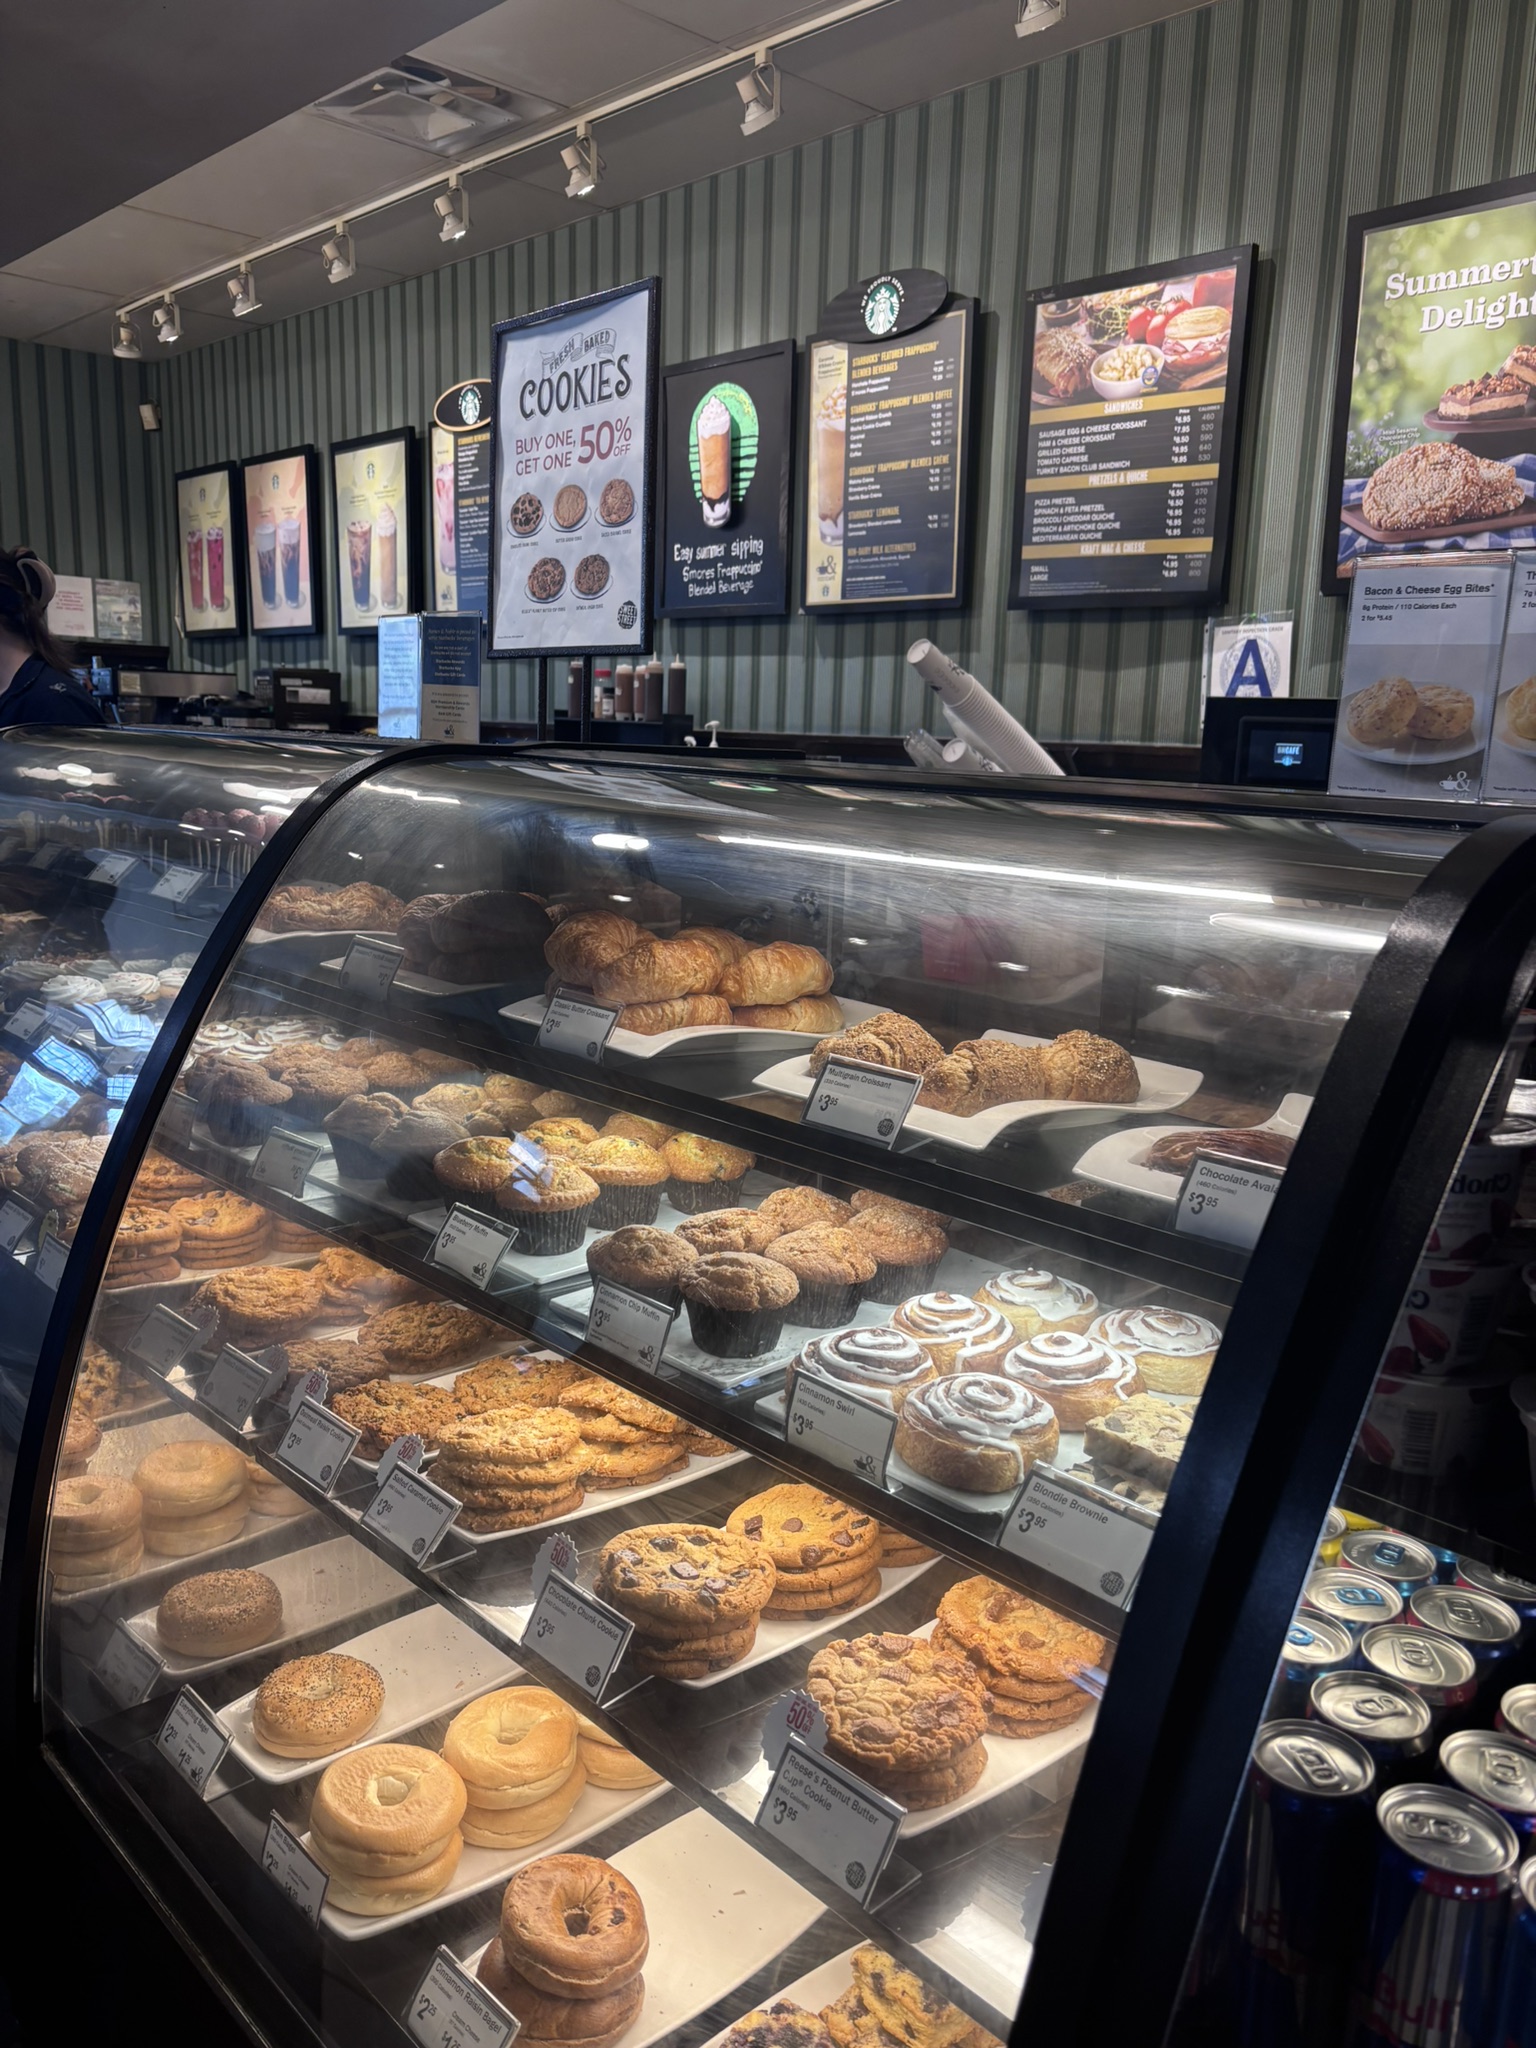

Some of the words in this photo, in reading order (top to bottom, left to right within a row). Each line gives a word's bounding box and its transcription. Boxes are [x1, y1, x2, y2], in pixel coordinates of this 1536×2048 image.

[867, 276, 891, 294] PROUDLY
[892, 277, 905, 296] SERVE
[549, 338, 575, 374] FRESH
[584, 331, 610, 352] BAKED
[519, 354, 632, 420] COOKIES
[1104, 399, 1143, 414] SANDWICHES
[1038, 440, 1052, 448] HAM
[1057, 436, 1080, 446] CHEESE
[1081, 433, 1116, 443] CROISSANT
[1201, 423, 1214, 431] 520
[1039, 428, 1066, 439] SAUSAGE
[1067, 427, 1080, 436] EGG
[1086, 424, 1111, 434] CHEESE
[1111, 419, 1148, 431] CROISSANT
[515, 436, 542, 455] BUY
[544, 429, 576, 450] ONE,
[577, 416, 632, 464] 50%
[515, 457, 540, 476] GET
[543, 451, 572, 470] ONE
[613, 444, 631, 457] OFF
[1037, 448, 1061, 457] GRILLED
[1061, 445, 1086, 455] CHEESE
[1037, 457, 1061, 467] TOMATO
[1061, 454, 1089, 464] CAPRESE
[1036, 467, 1059, 475] TURKEY
[1059, 464, 1081, 473] BACON
[1081, 463, 1098, 472] CLUB
[1098, 459, 1131, 470] SANDWICH
[1034, 507, 1059, 515] SPINACH
[1080, 504, 1104, 512] PRETZEL
[1051, 497, 1076, 505] PRETZEL
[1033, 516, 1061, 525] BROCCOLI
[1063, 514, 1090, 523] CHEDDAR
[1091, 512, 1115, 521] QUICHE
[1033, 526, 1057, 534] SPINACH
[1063, 523, 1095, 531] ARTICHOKE
[1097, 522, 1120, 530] QUICHE
[1032, 534, 1078, 543] MEDITERRANEAN
[1079, 532, 1102, 540] QUICHE
[674, 544, 693, 564] Easy
[696, 543, 726, 560] summer
[731, 535, 764, 560] sipping
[688, 580, 716, 597] Blended
[718, 580, 754, 594] Beverage
[1364, 586, 1393, 596] Bacon
[1395, 586, 1402, 595] &
[1404, 585, 1441, 595] Cheese
[1443, 584, 1462, 595] Egg
[618, 605, 637, 616] SWEET
[1372, 603, 1394, 611] Protein
[617, 614, 637, 625] STREET
[1225, 639, 1273, 698] A
[554, 1000, 571, 1011] Classic
[571, 1004, 586, 1014] Butter
[586, 1009, 610, 1020] Croissant
[828, 1068, 860, 1083] Multigrain
[861, 1076, 892, 1089] Croissant
[1200, 1167, 1249, 1187] Chocolate
[1212, 1182, 1237, 1195] Calories)
[600, 1286, 627, 1306] Cinnamon
[628, 1300, 640, 1312] Chip
[642, 1306, 660, 1321] Muffin
[798, 1382, 835, 1406] Cinnamon
[836, 1400, 855, 1416] Swirl
[330, 1428, 345, 1443] Cookie
[392, 1473, 407, 1488] Salted
[407, 1484, 427, 1503] Caramel
[426, 1499, 444, 1515] Cookie
[1032, 1482, 1068, 1505] Blondie
[1069, 1499, 1109, 1524] Brownie
[1041, 1502, 1064, 1518] Calories)
[548, 1586, 578, 1611] Chocolate
[577, 1606, 597, 1625] Chunk
[597, 1621, 620, 1641] Cookie
[788, 1755, 820, 1784] Reese's
[820, 1778, 851, 1806] Peanut
[851, 1799, 880, 1825] Butter
[804, 1785, 832, 1811] Cookie
[435, 1962, 465, 1996] Cinnamon
[464, 1992, 483, 2016] Raisin
[482, 2011, 502, 2034] Bagel
